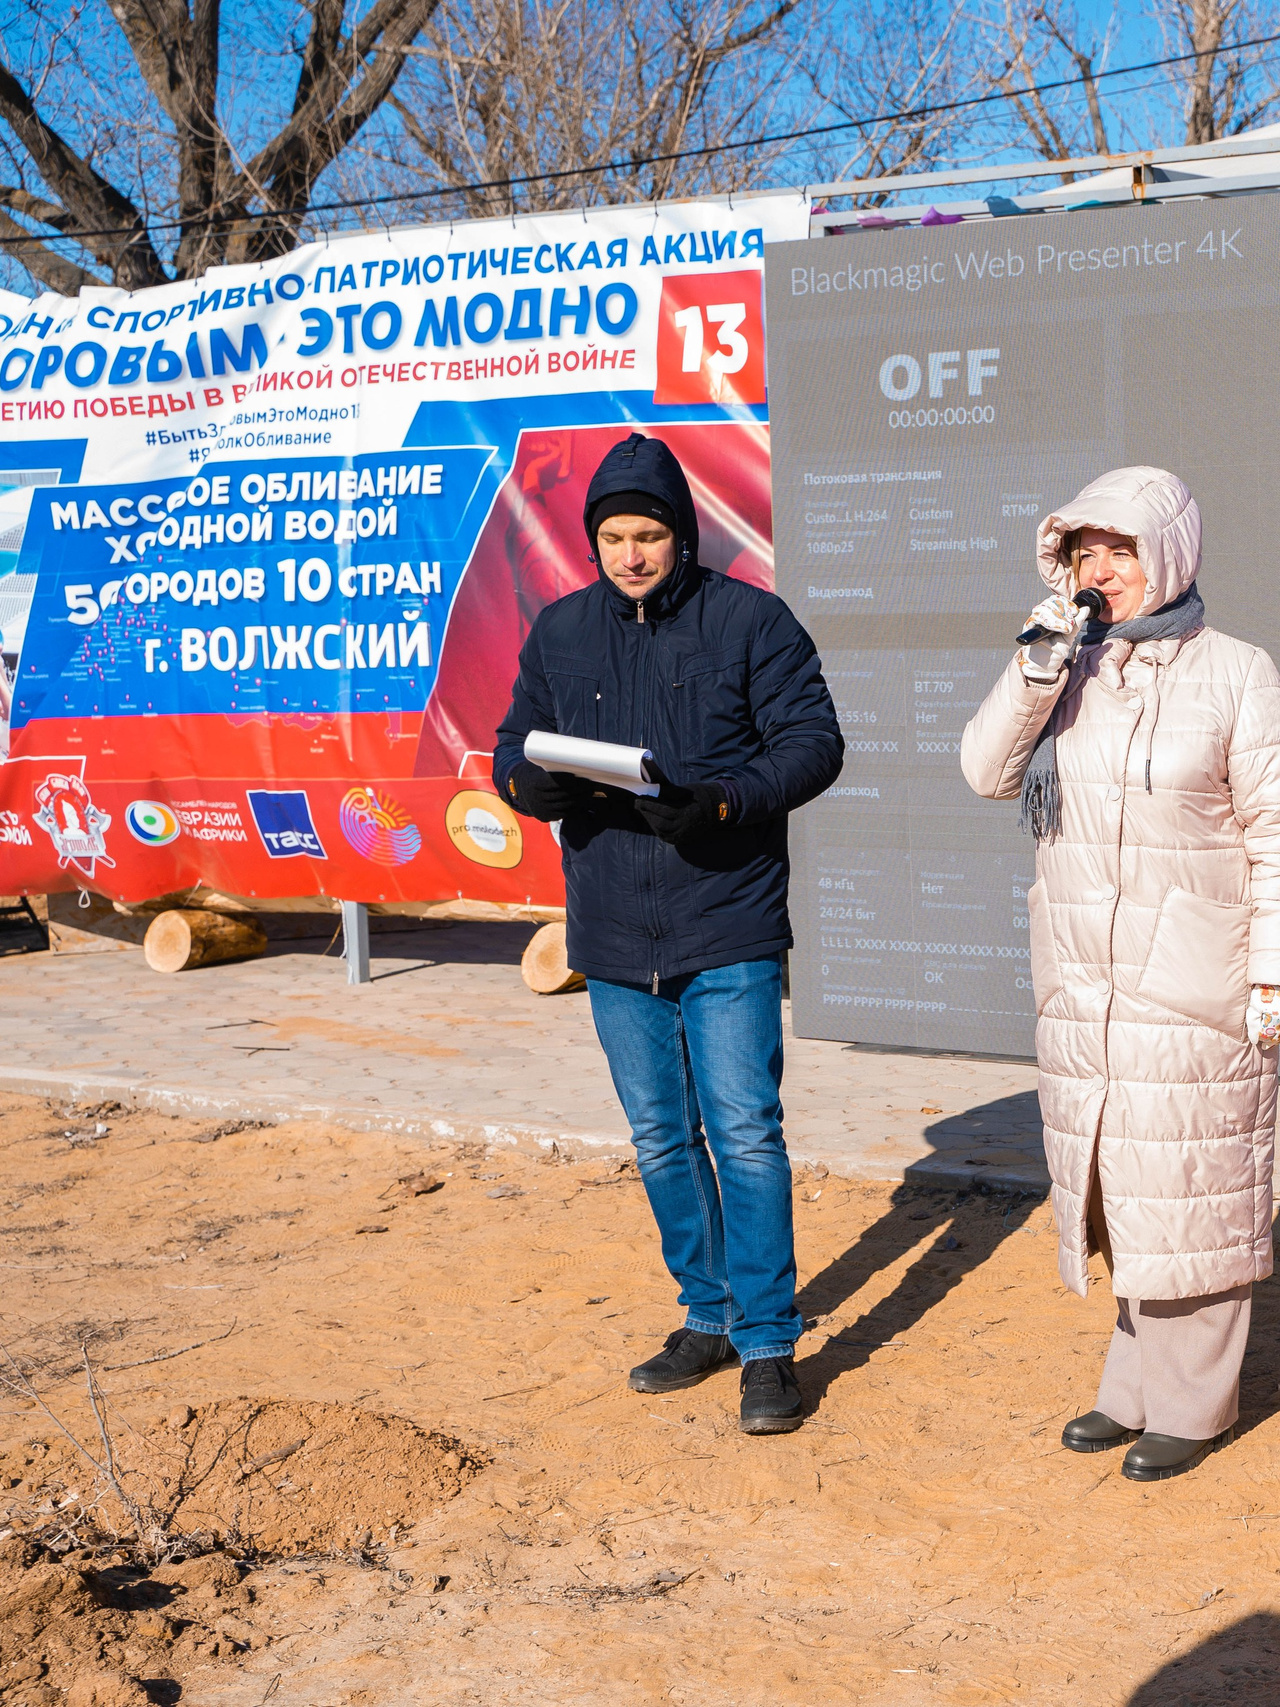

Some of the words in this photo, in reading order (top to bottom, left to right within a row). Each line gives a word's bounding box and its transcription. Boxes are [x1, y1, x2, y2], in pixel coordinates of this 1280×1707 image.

[640, 228, 765, 266] АКЦИЯ
[791, 256, 945, 295] Blackmagic
[954, 248, 1025, 280] Web
[1038, 237, 1187, 274] Presenter
[1196, 228, 1245, 260] 4K
[298, 301, 401, 357] ЭТО
[414, 283, 639, 348] МОДНО
[675, 303, 749, 375] 13
[74, 391, 196, 418] ПОБЕДЫ
[203, 388, 225, 408] В
[548, 344, 637, 374] ВОЙНЕ
[878, 348, 1001, 401] OFF
[888, 405, 995, 429] 00:00:00:00
[240, 463, 444, 505] ОБЛИВАНИЕ
[804, 473, 868, 486] Потоковая
[870, 470, 943, 485] трансляция
[854, 509, 888, 523] H.264
[909, 507, 954, 522] Custom
[1002, 502, 1040, 518] RTMP
[284, 498, 398, 545] ВОДОЙ
[806, 540, 855, 556] 1080p25
[910, 537, 968, 552] Streaming
[969, 536, 999, 551] High
[277, 557, 332, 603] 10
[338, 561, 442, 598] СТРАН
[807, 586, 874, 600] Видеовход
[182, 610, 436, 672] ВОЛЖСКИЙ
[914, 681, 954, 694] BT.709
[916, 711, 938, 724] Нет
[818, 878, 833, 890] 48
[834, 878, 855, 892] кГц
[921, 882, 944, 895] Нет
[819, 906, 853, 920] 24/24
[855, 910, 877, 921] бит
